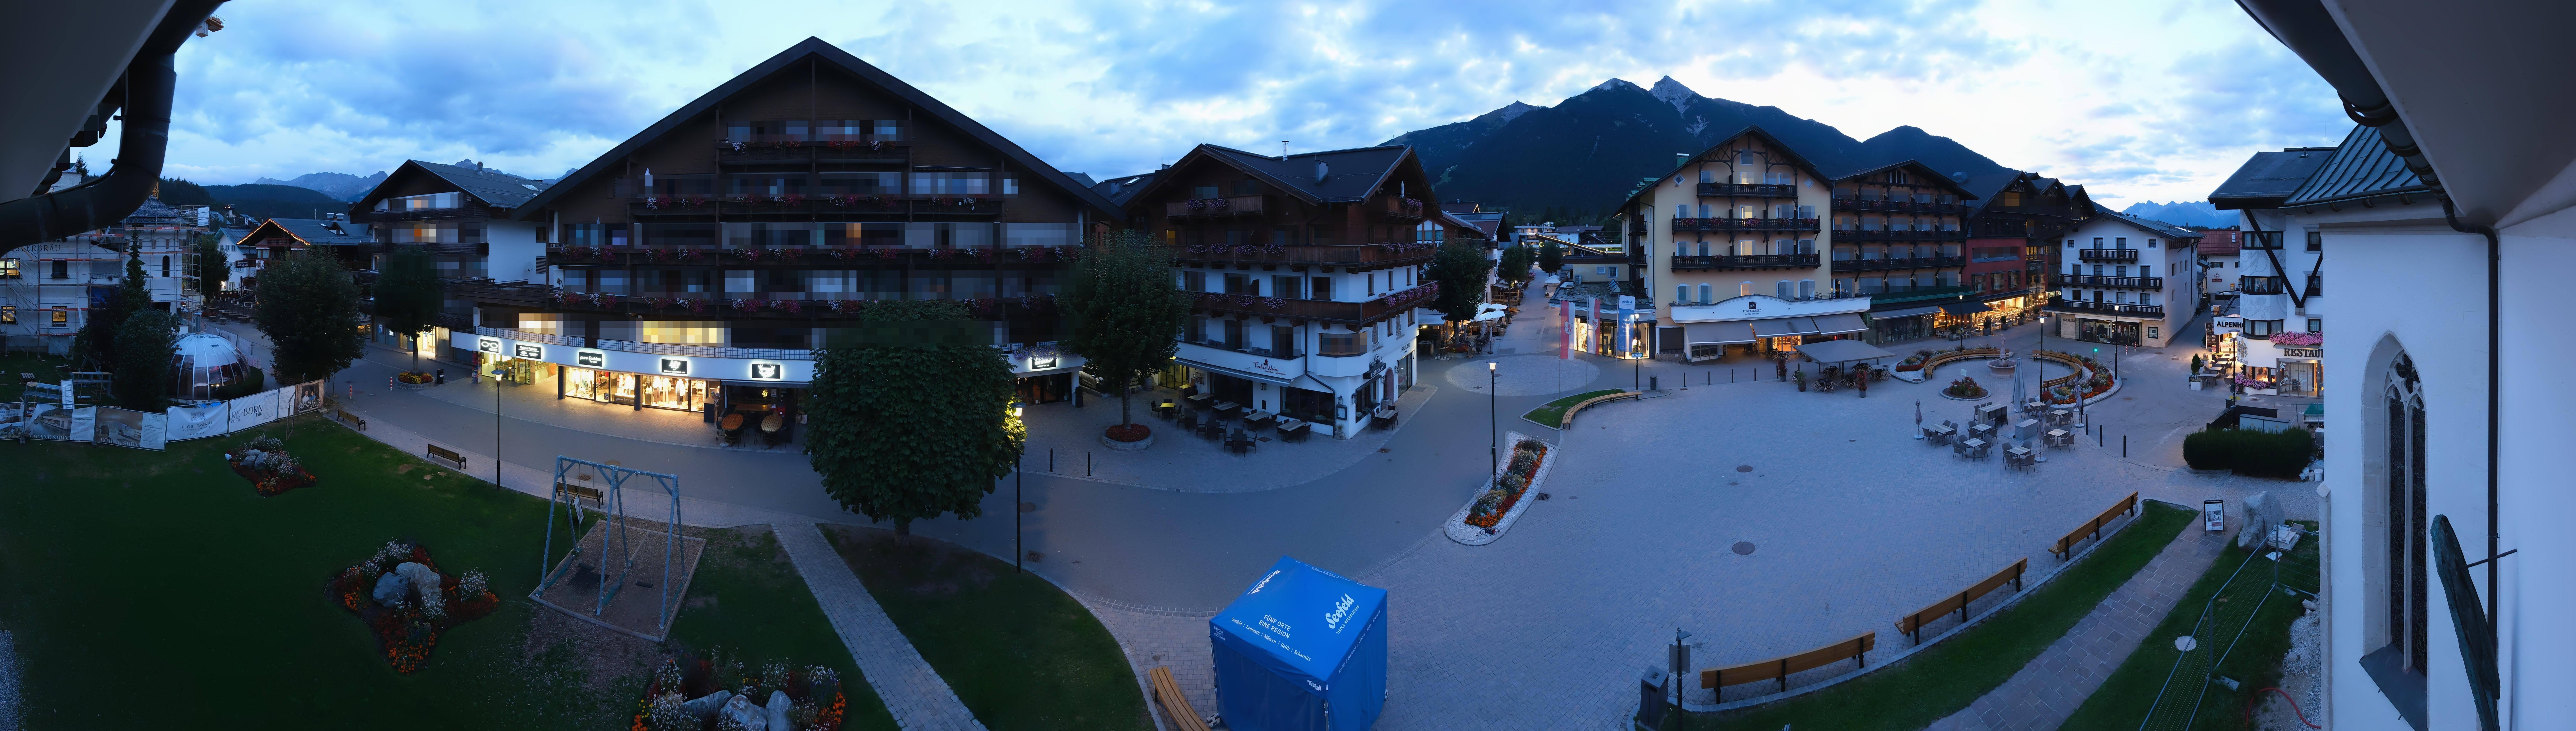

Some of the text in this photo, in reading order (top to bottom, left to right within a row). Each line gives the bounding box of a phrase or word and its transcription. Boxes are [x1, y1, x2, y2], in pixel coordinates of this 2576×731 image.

[1401, 343, 1410, 352] SAILER
[1371, 364, 1385, 377] RESTAURANT
[1325, 592, 1354, 629] Seefeld
[1264, 614, 1291, 631] FÜNF ORTE
[1336, 605, 1360, 634] TIROLS HOCHPLATEAU
[1214, 632, 1225, 641] plateau
[1259, 619, 1290, 639] EINE REGION
[1232, 617, 1243, 626] Seefeld
[1246, 625, 1260, 635] Leutasch
[1264, 634, 1276, 644] Mösern
[1294, 650, 1311, 661] Scharnitz
[1307, 680, 1321, 691] Tirol
